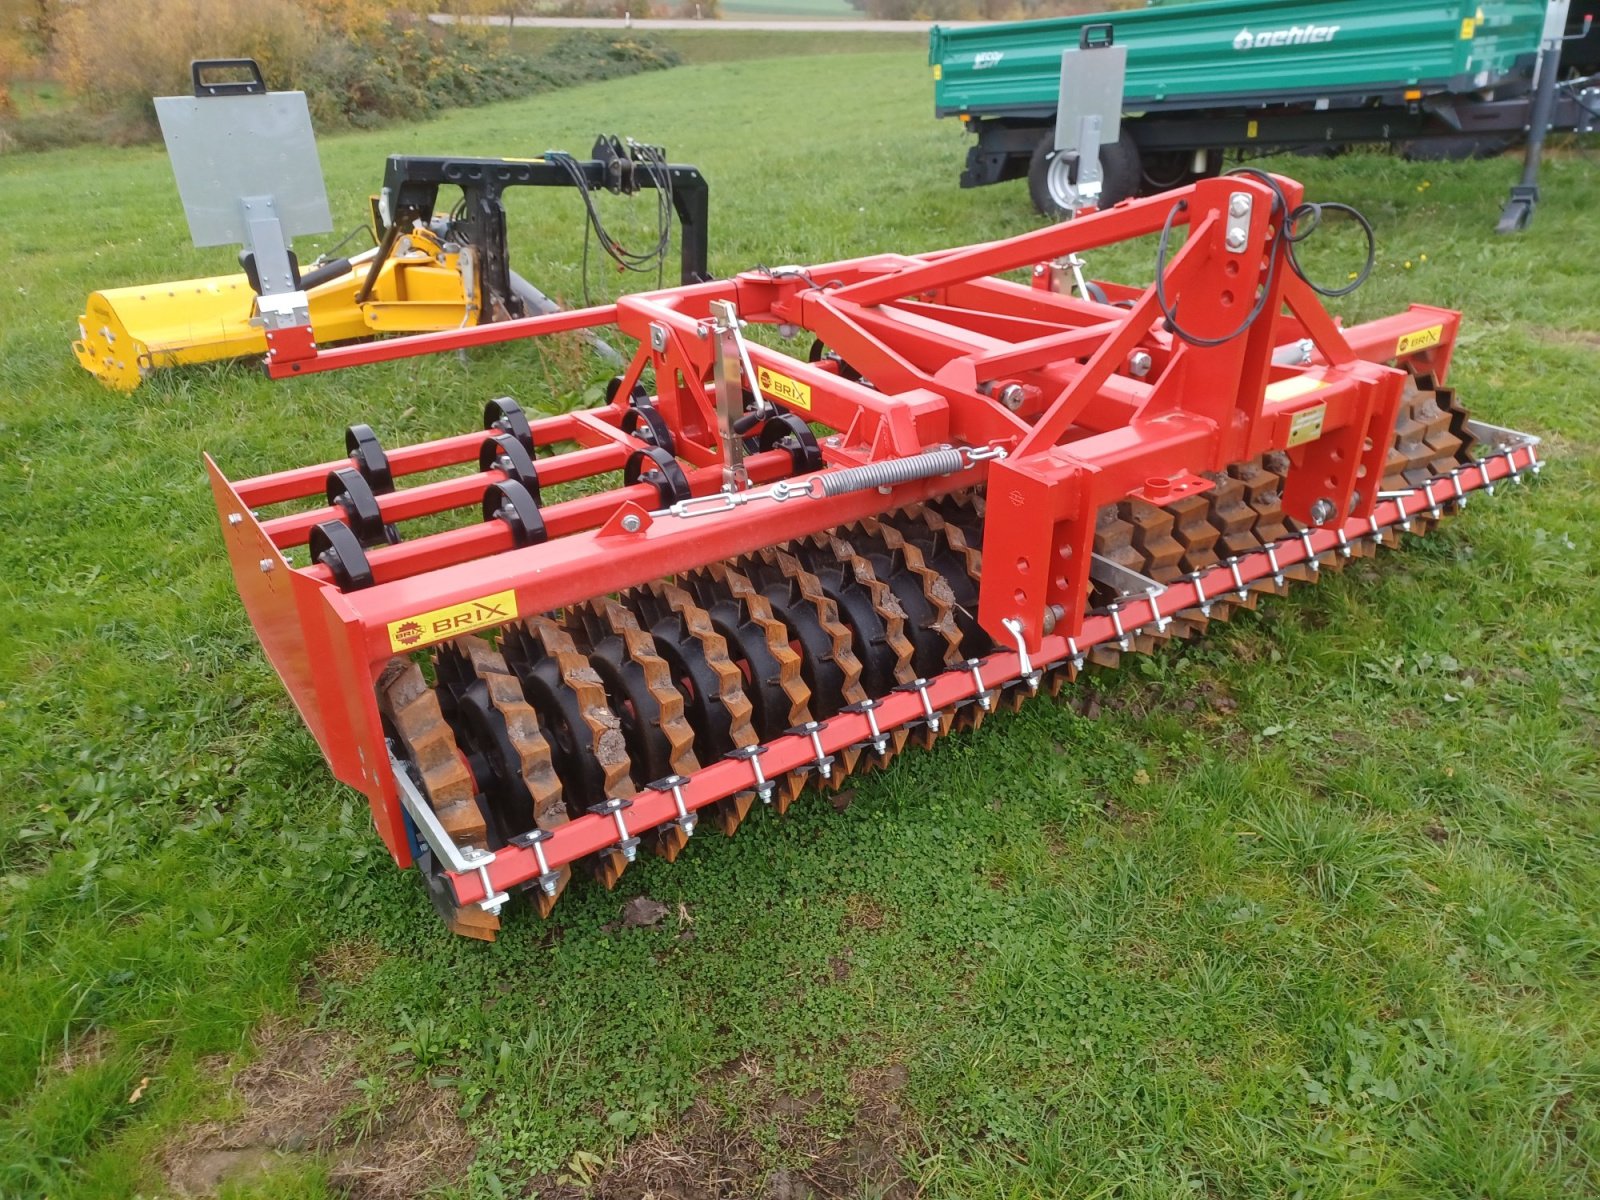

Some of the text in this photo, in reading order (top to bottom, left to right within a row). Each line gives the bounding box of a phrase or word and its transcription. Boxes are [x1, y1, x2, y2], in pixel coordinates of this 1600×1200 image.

[1254, 24, 1341, 48] oehler
[1410, 329, 1437, 347] BRIX
[774, 381, 806, 405] BRIX
[432, 602, 510, 634] BRIX
[395, 626, 426, 640] BRIX
